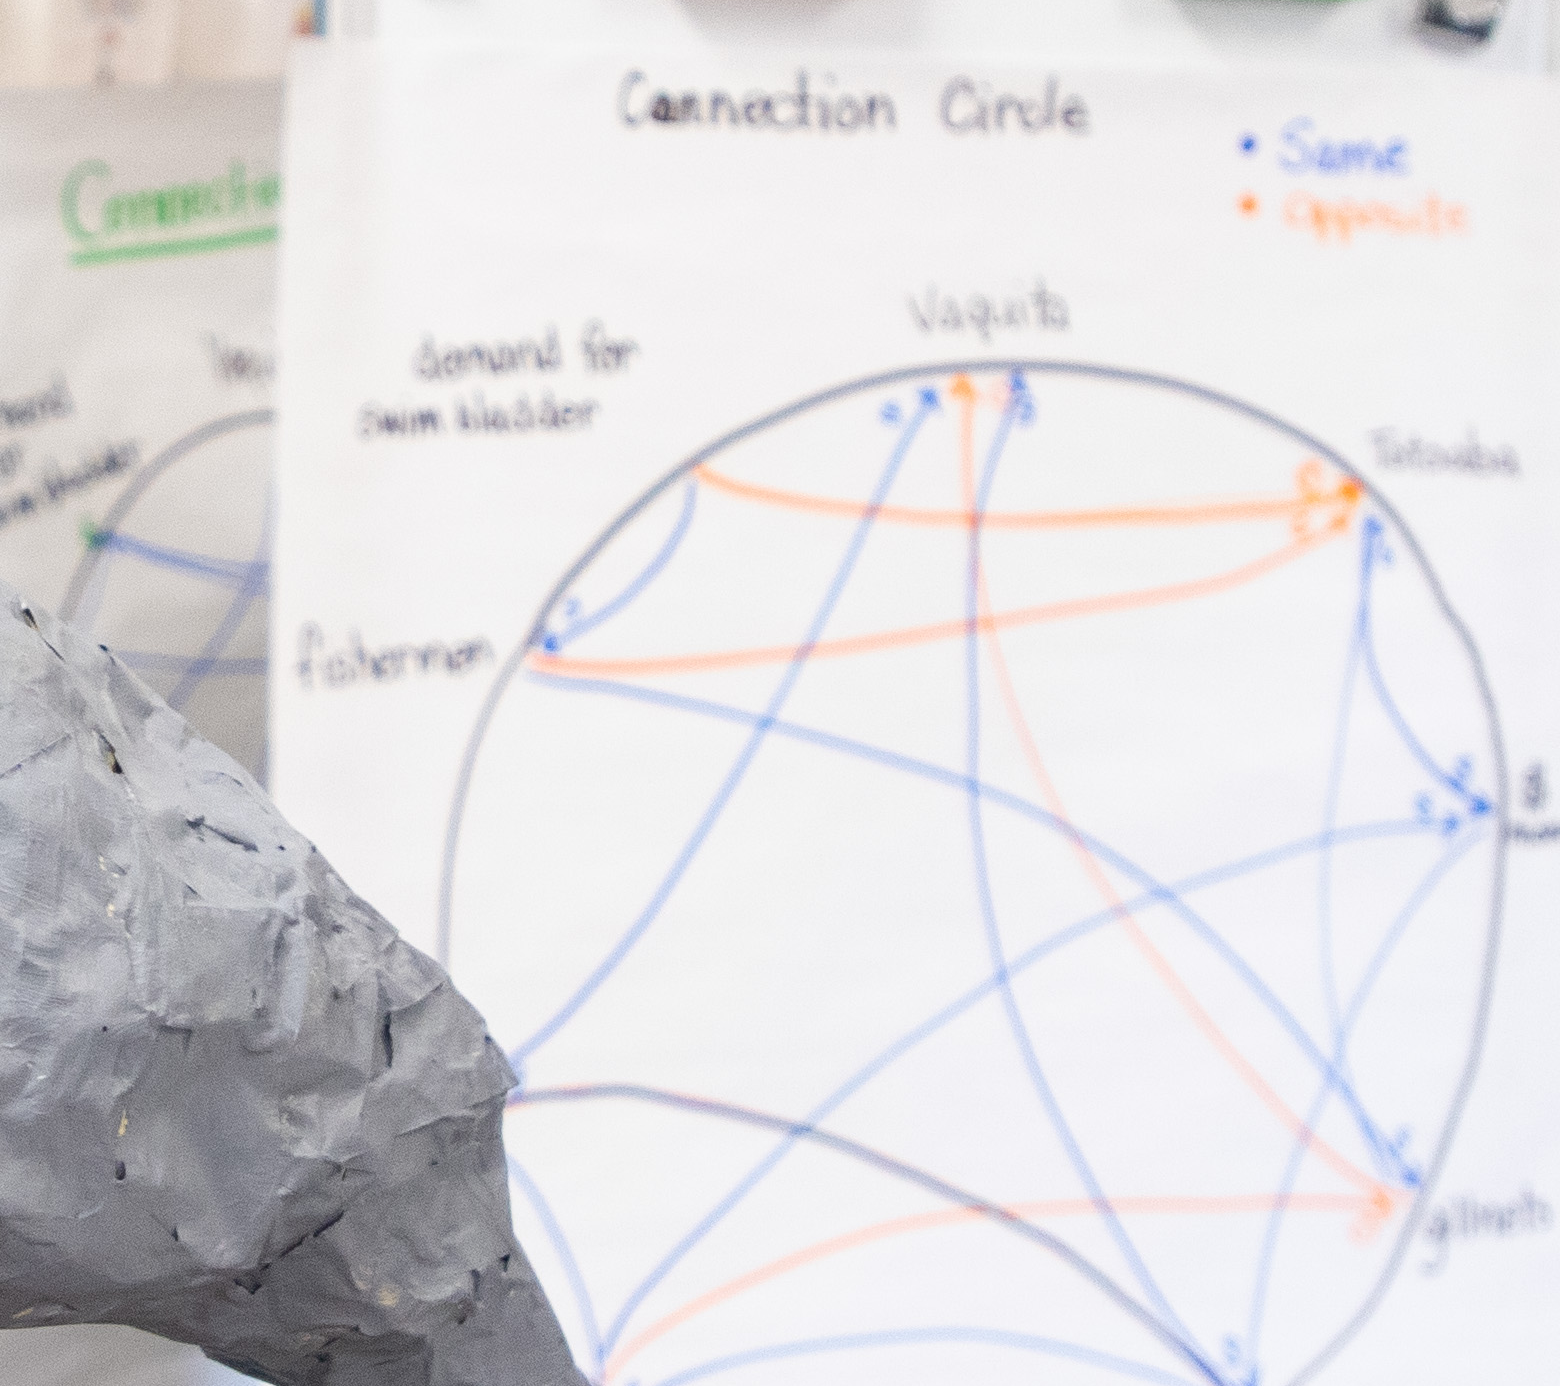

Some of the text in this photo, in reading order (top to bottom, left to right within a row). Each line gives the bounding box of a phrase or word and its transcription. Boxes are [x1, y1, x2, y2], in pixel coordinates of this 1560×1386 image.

[617, 68, 1093, 137] Connection Circle
[1278, 121, 1411, 179] Same
[905, 273, 1074, 343] Vaquita
[411, 317, 640, 383] demand for
[356, 389, 602, 441] swim bladder
